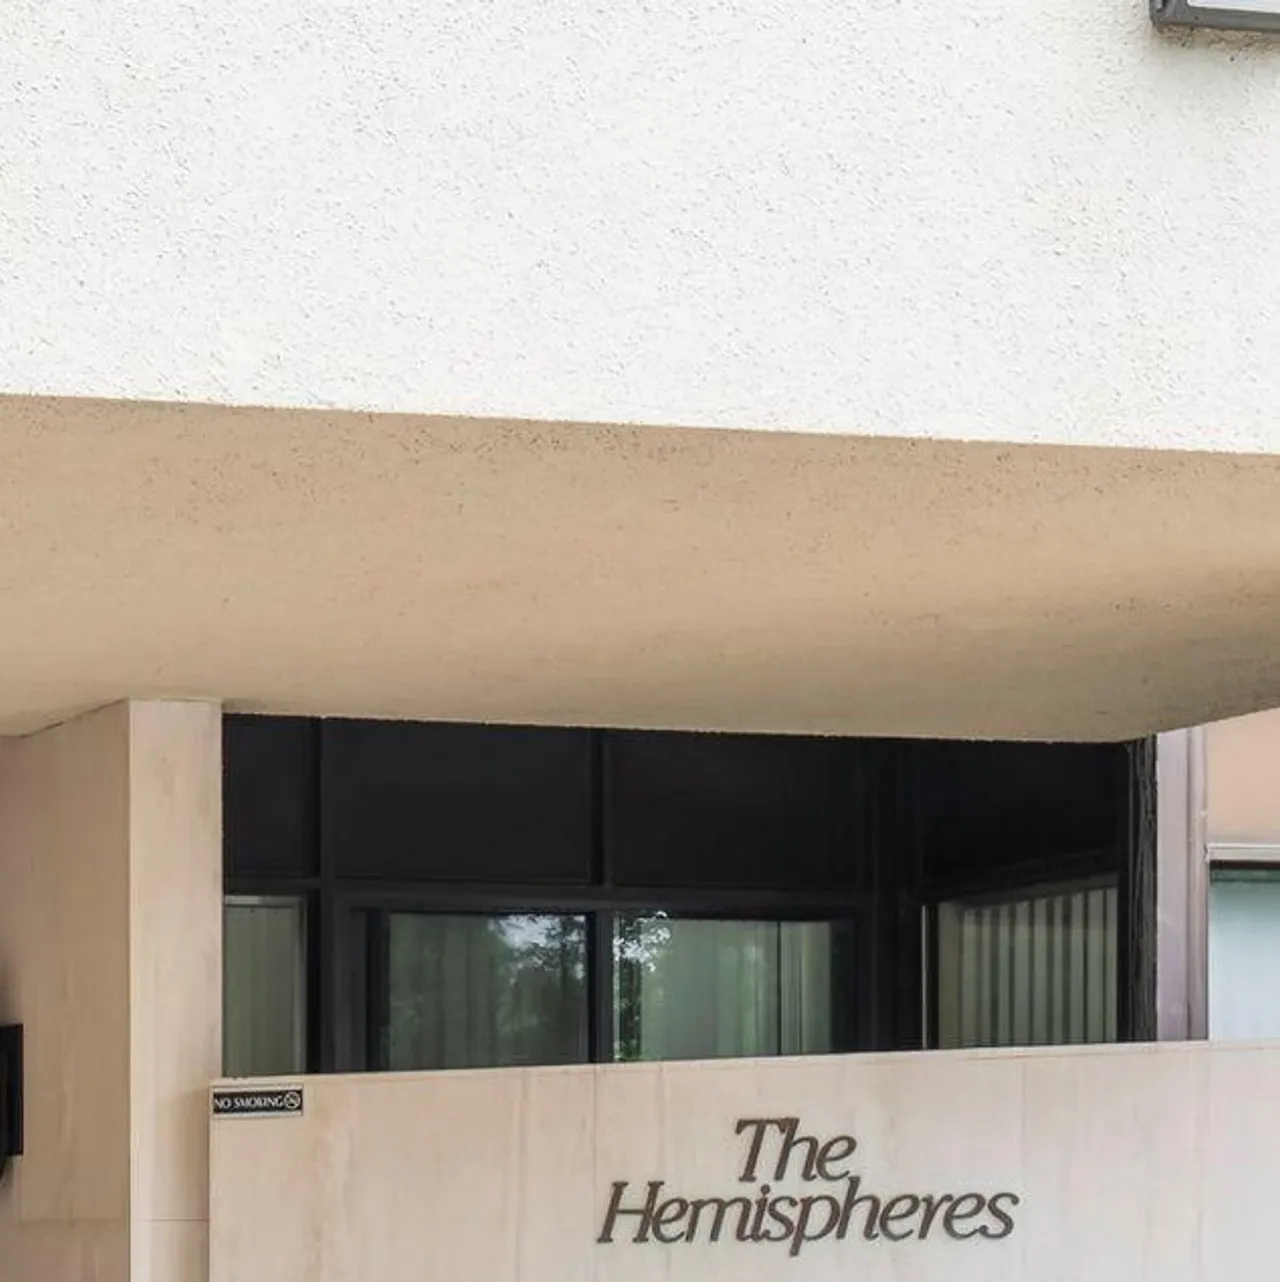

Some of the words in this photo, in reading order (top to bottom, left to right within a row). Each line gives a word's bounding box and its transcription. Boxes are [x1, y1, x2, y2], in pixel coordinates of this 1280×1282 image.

[215, 1098, 231, 1109] NO
[735, 1117, 856, 1182] The
[597, 1176, 1020, 1256] Hemispheres
